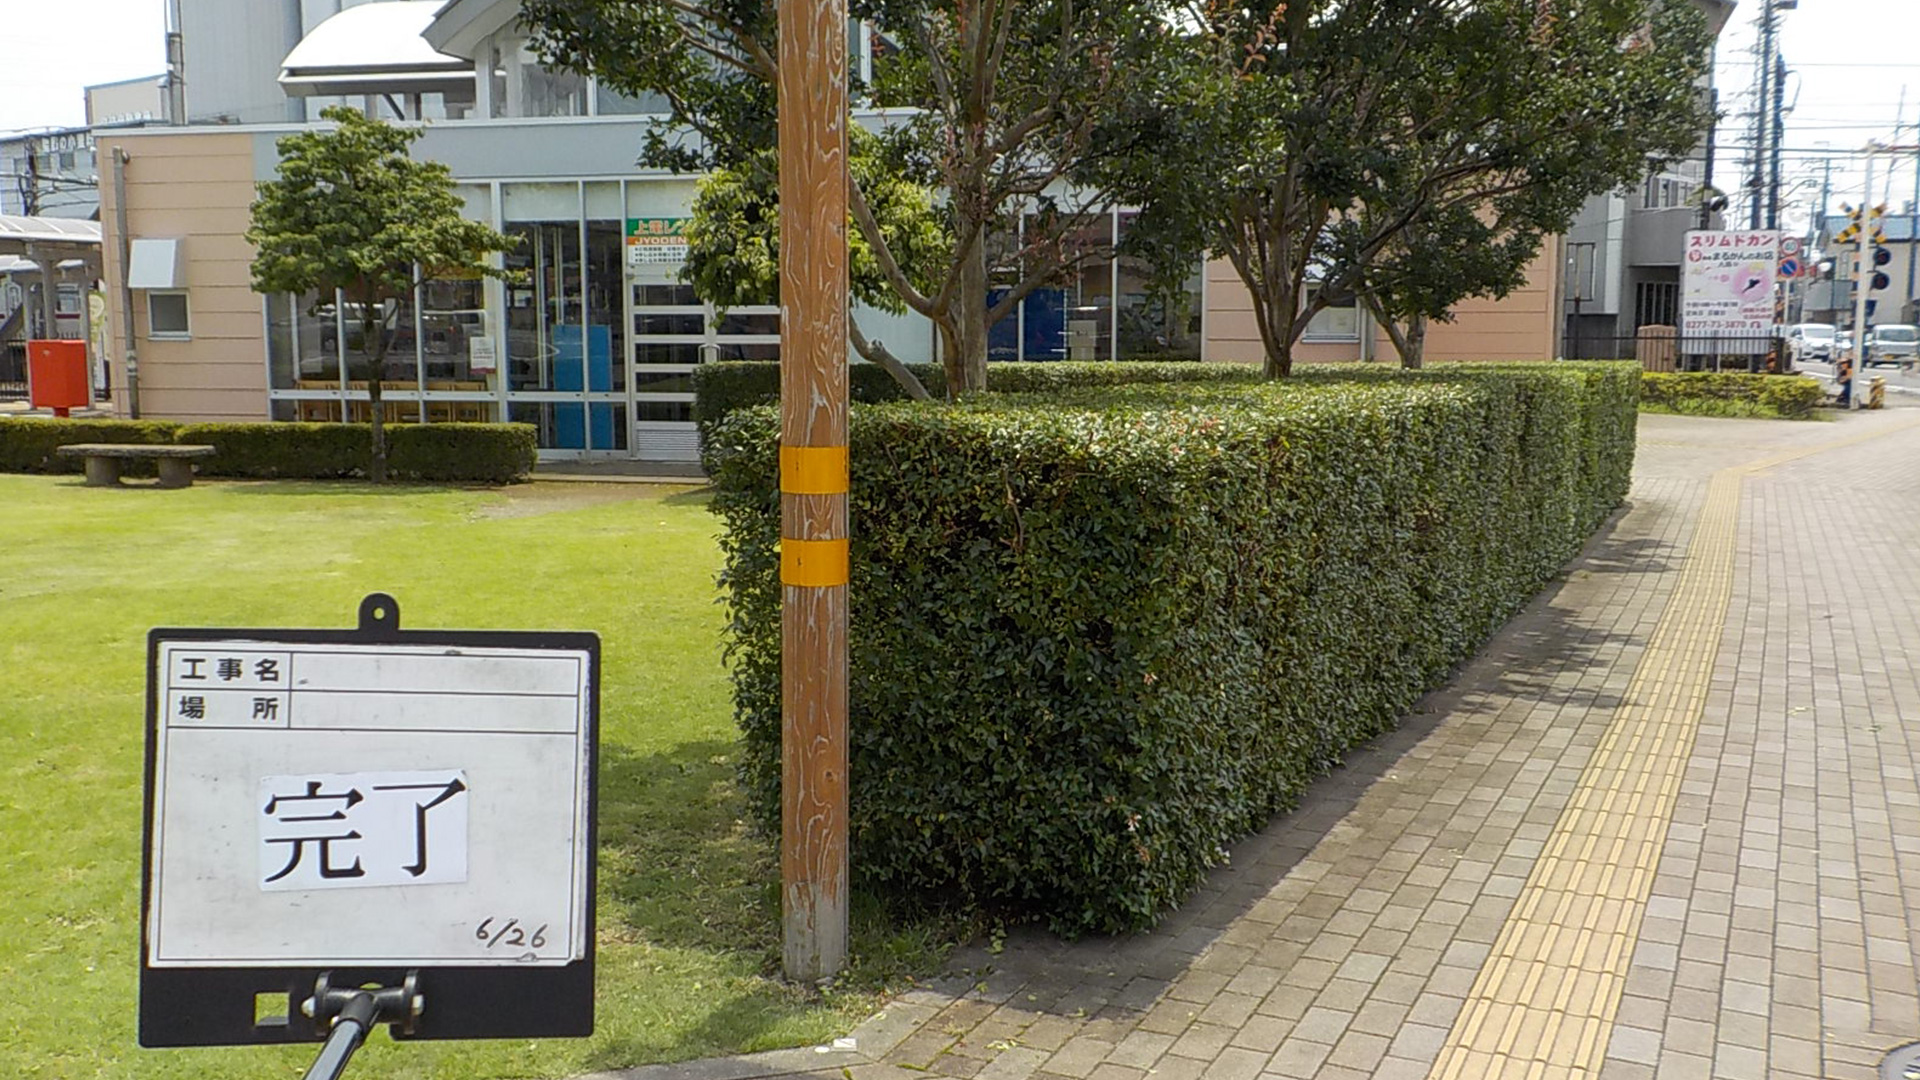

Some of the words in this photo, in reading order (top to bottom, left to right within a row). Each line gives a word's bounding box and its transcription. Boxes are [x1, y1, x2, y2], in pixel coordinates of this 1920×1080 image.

[1690, 235, 1774, 247] スリムドカン
[180, 657, 280, 684] 工事名
[264, 779, 467, 883] 完了
[475, 917, 548, 949] 6/26
